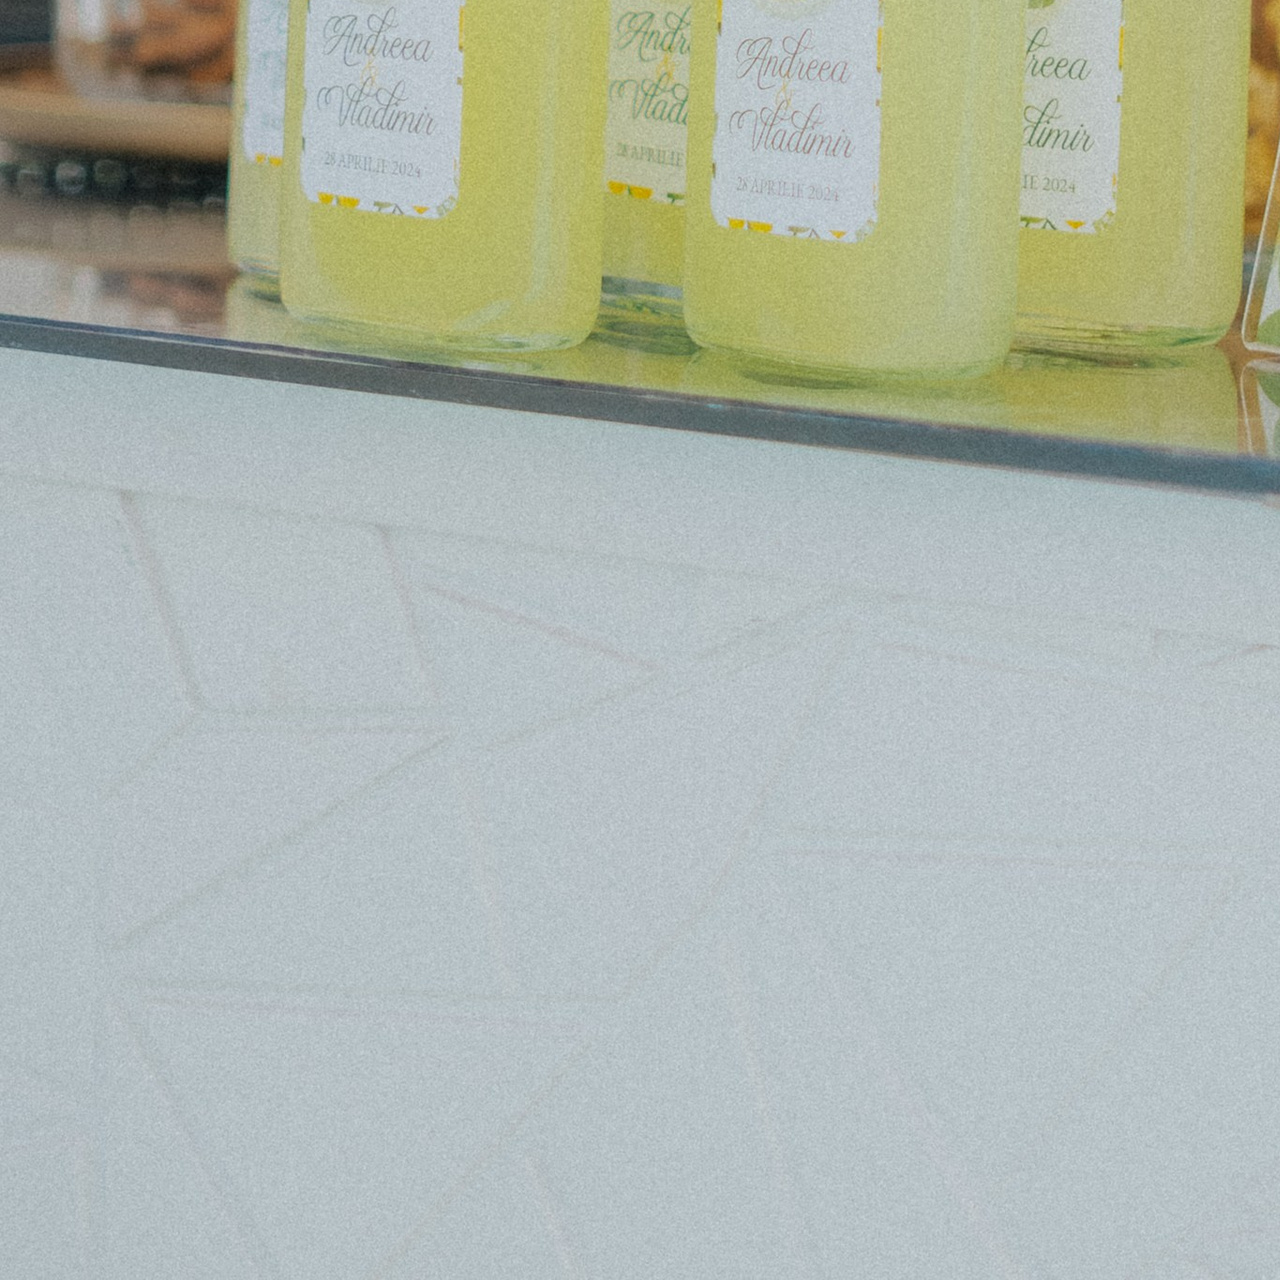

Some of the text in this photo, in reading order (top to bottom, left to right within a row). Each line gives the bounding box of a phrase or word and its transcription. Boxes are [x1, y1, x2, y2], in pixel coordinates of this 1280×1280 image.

[323, 6, 434, 67] Andreea
[616, 6, 691, 62] Andr
[736, 28, 850, 90] Andreea
[317, 76, 437, 135] Vladimir
[728, 99, 856, 158] Vladimir
[337, 153, 389, 174] APRILIE
[391, 160, 421, 178] 2024
[749, 178, 804, 198] APRILIE
[808, 186, 839, 201] 2024
[1043, 176, 1076, 193] 2024
